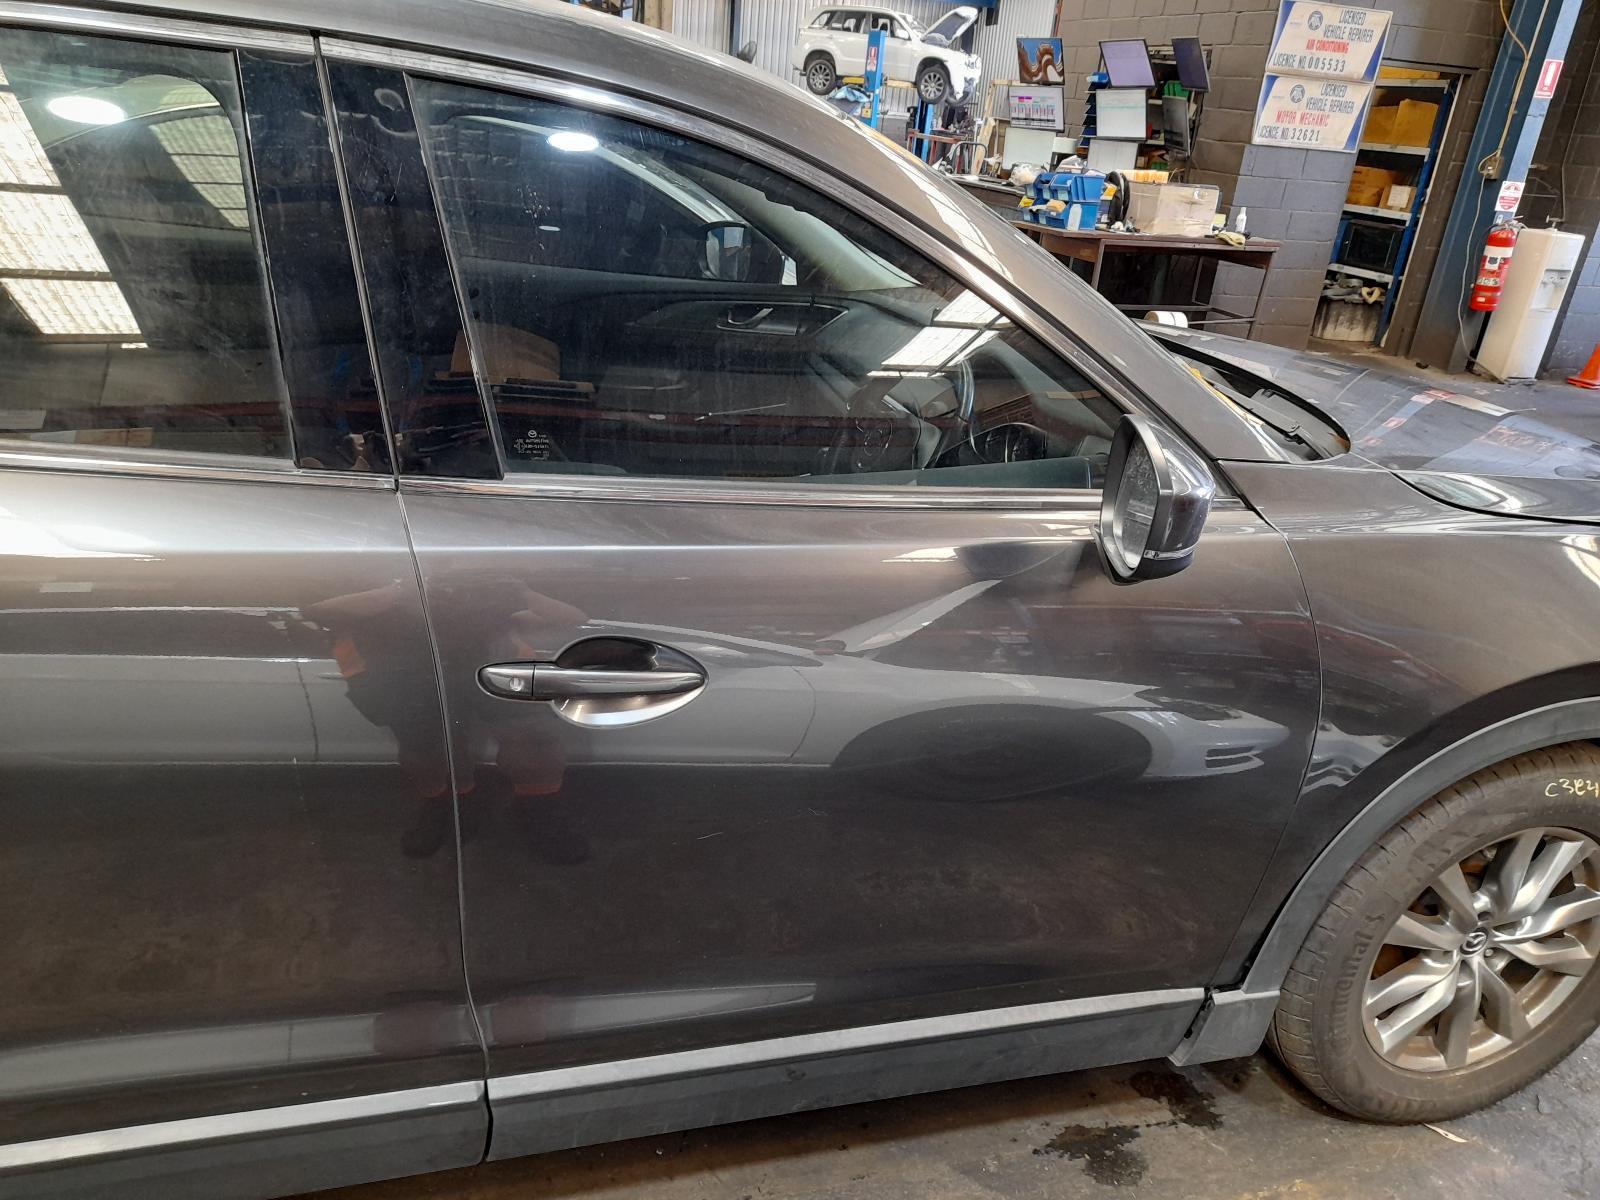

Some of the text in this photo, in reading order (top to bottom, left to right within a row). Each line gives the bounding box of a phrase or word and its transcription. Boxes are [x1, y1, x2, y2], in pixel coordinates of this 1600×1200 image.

[1323, 24, 1374, 42] VEHICLE REPAIRER
[1308, 56, 1346, 72] 005533
[1306, 96, 1355, 114] VEHICLE REPAIRER
[1276, 111, 1329, 127] MOTOR MECHANIC
[1291, 127, 1320, 142] 32621
